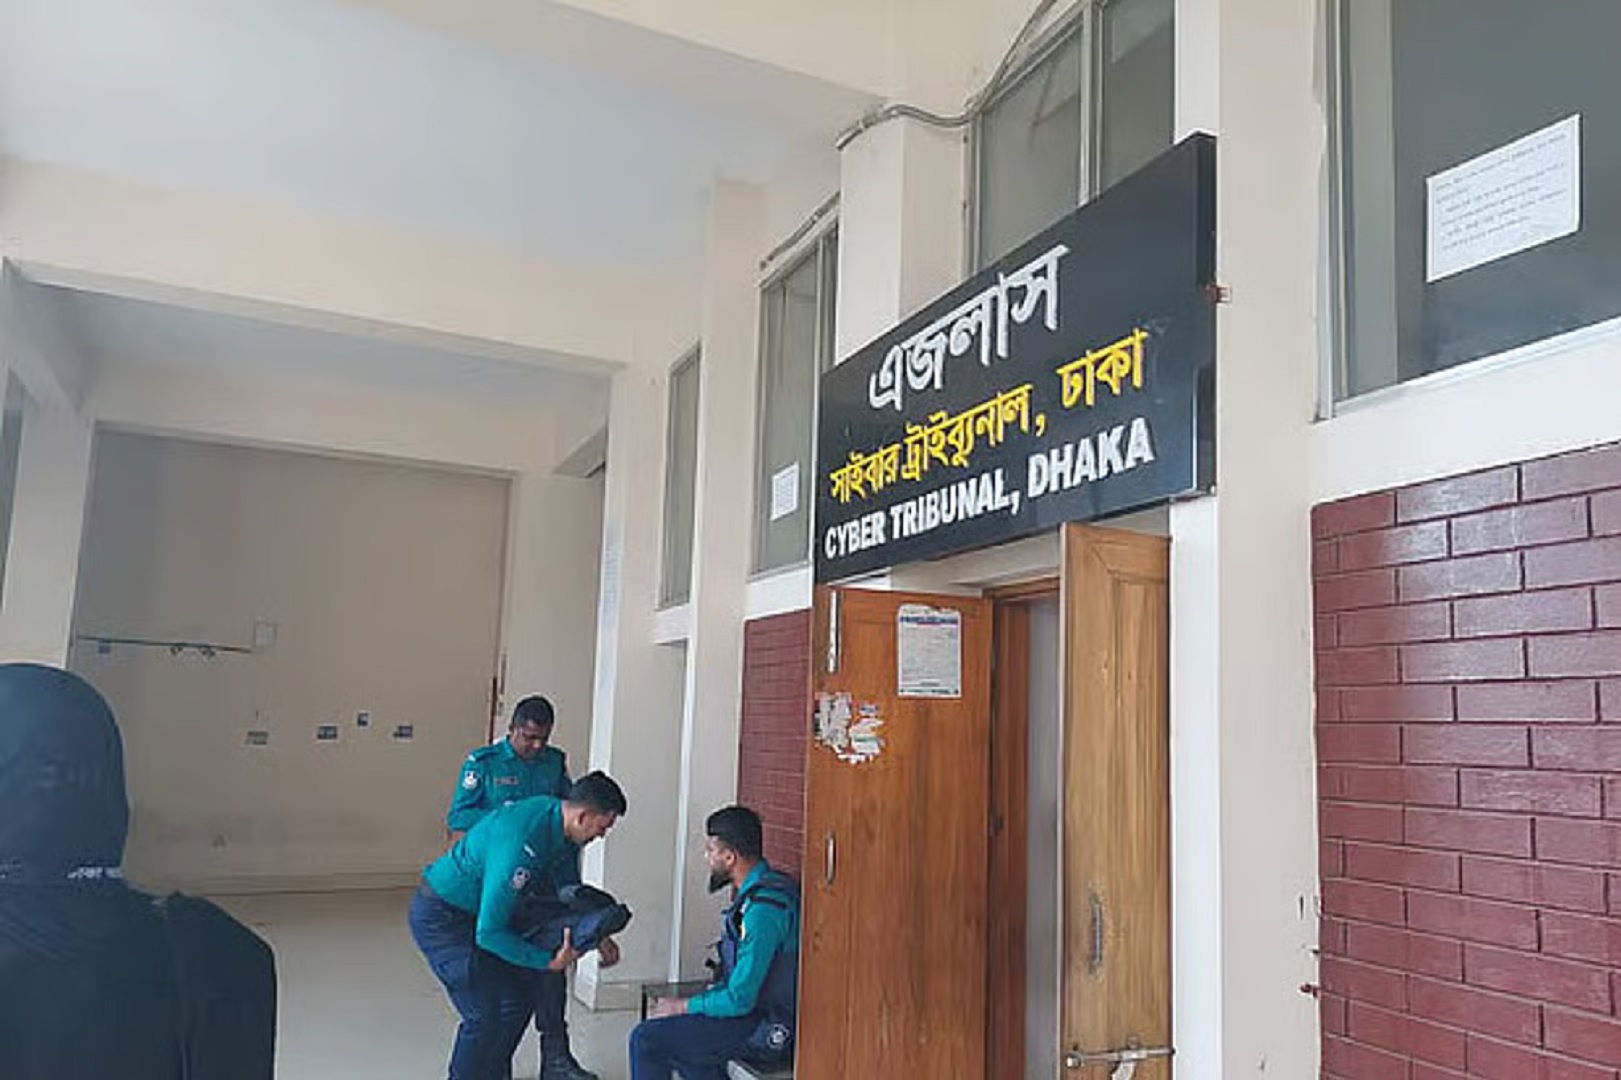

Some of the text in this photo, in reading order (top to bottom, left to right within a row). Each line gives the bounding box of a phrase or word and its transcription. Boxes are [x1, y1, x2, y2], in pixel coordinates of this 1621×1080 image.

[870, 244, 1069, 411] এজলাস
[824, 417, 1155, 560] CYBER TRIBUNAL, DHAKA
[829, 442, 901, 504] সাইবার
[902, 384, 1046, 481] ট্রাইব্যুনাল,
[1056, 327, 1148, 408] ঢাকা
